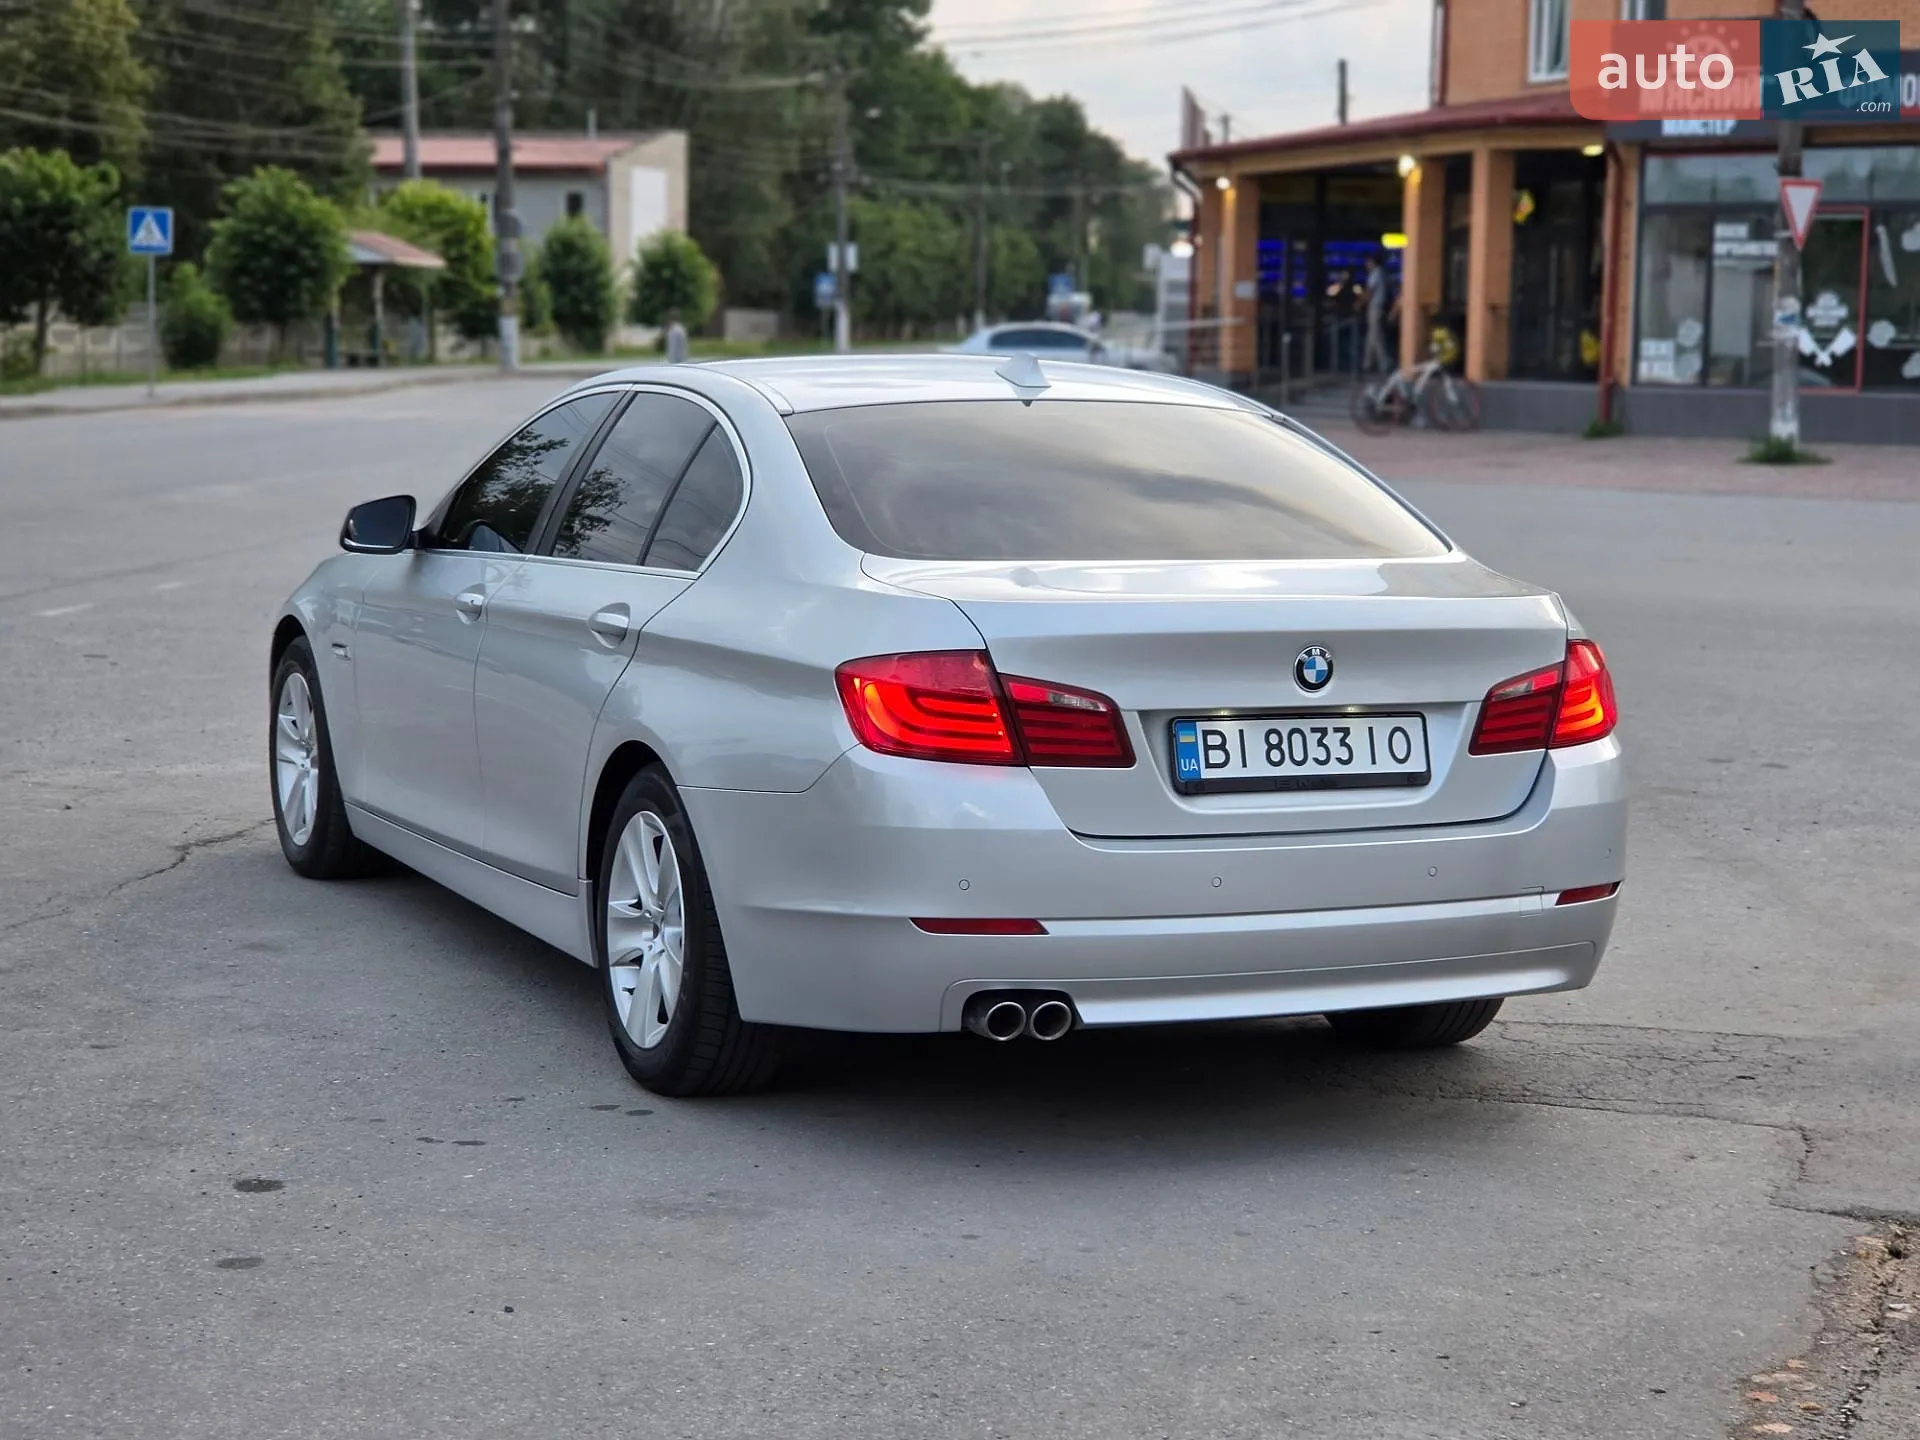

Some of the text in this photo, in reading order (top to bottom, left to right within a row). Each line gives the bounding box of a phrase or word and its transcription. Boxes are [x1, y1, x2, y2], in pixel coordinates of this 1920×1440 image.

[1201, 729, 1247, 769] BI
[1264, 727, 1354, 767] 8033
[1181, 758, 1199, 772] UA
